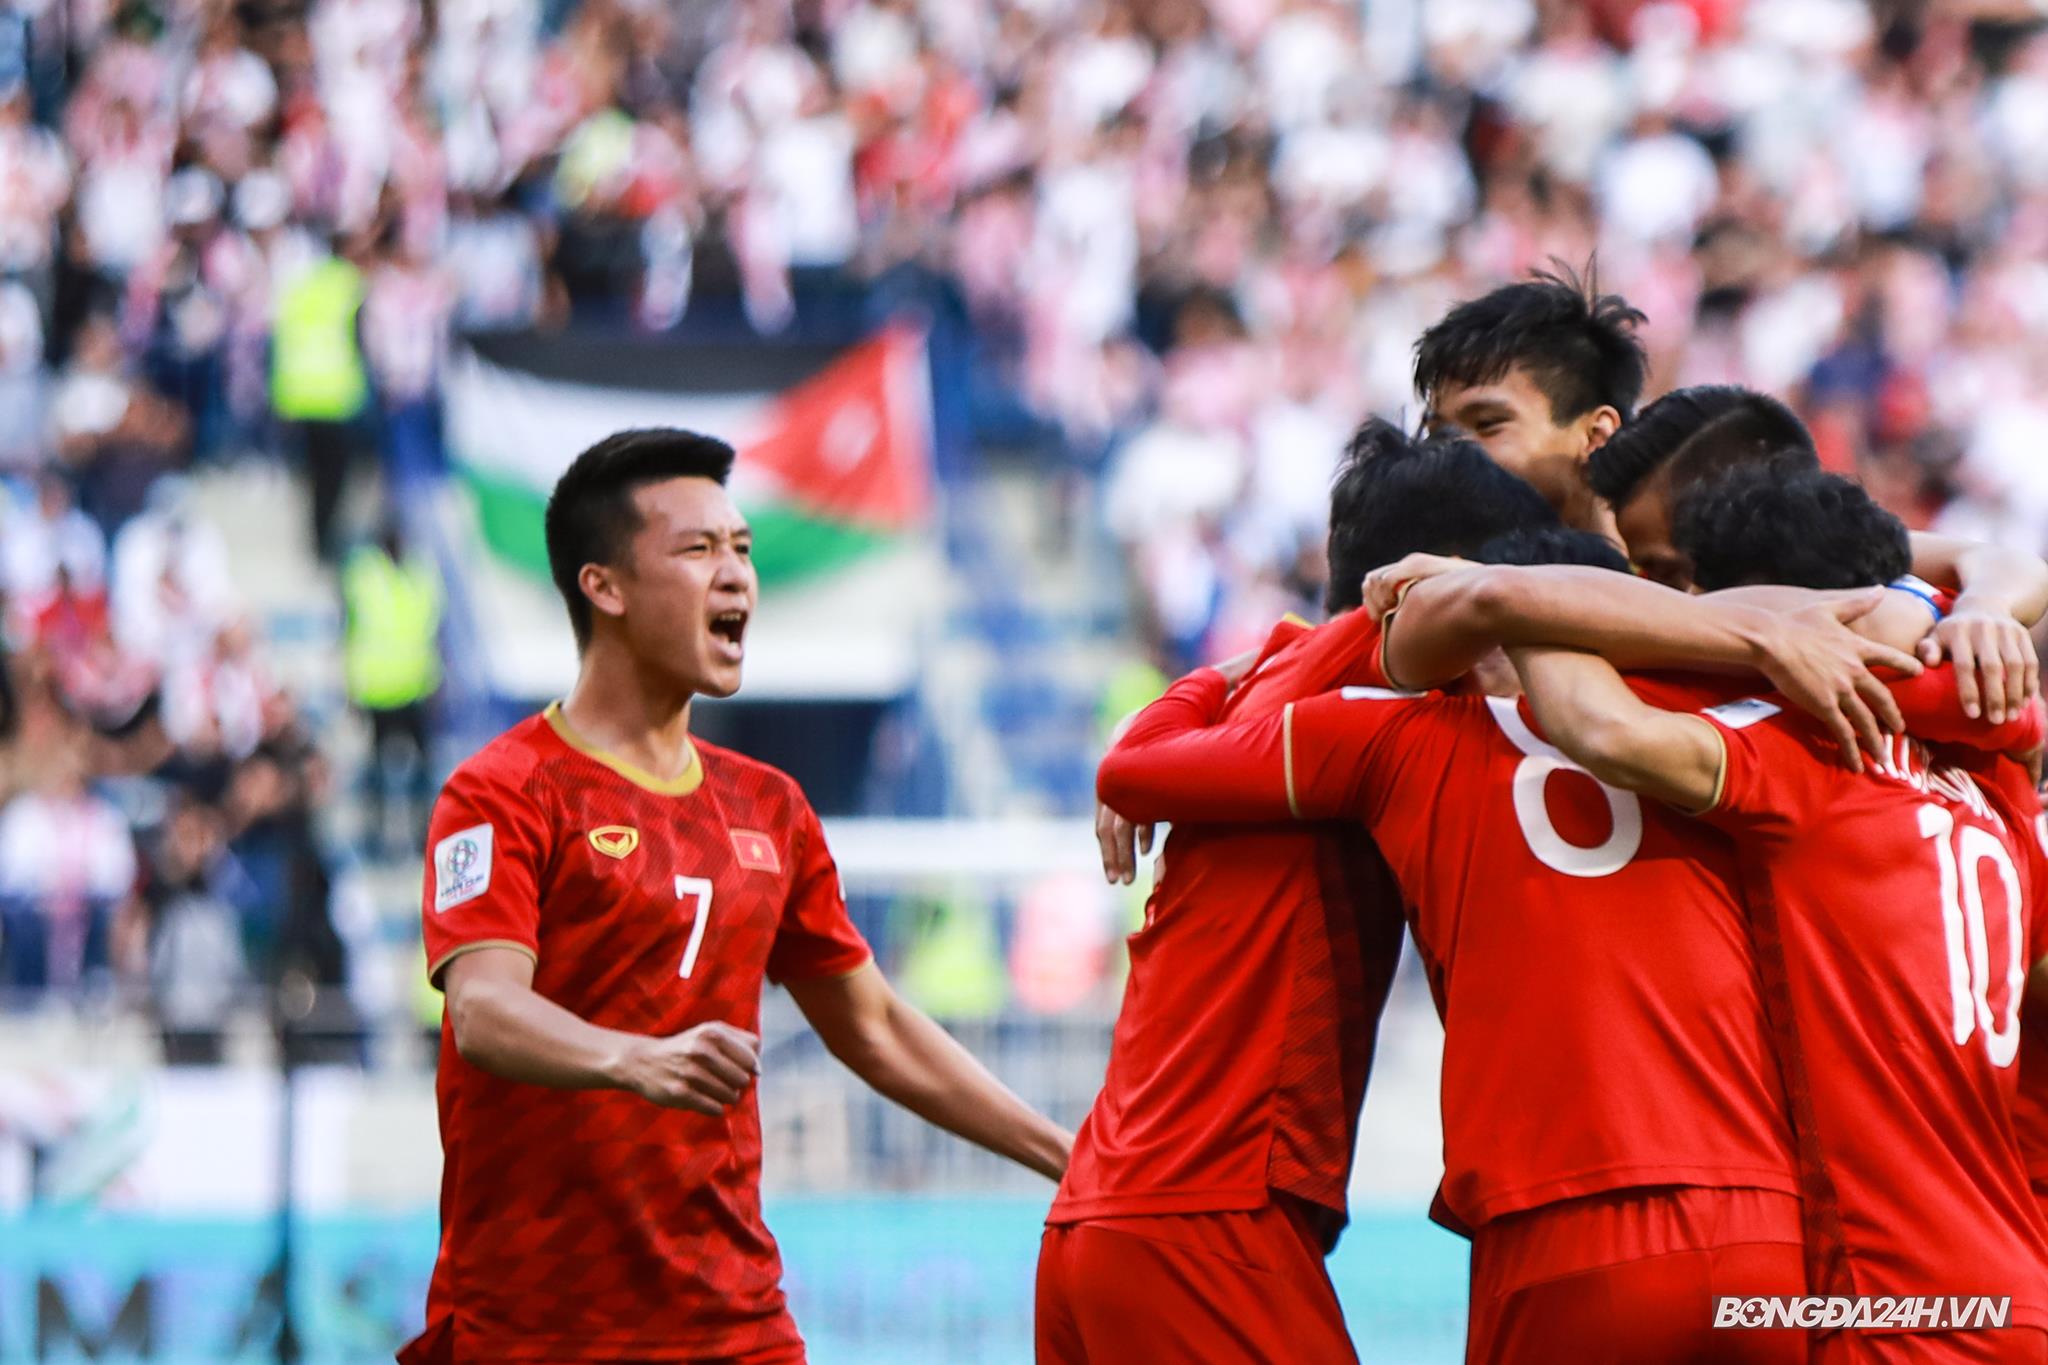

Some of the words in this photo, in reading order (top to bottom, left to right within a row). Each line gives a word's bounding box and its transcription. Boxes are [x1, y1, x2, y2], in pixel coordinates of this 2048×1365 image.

[1486, 696, 1643, 877] 8
[675, 875, 713, 979] 7
[1918, 803, 2025, 1068] 10
